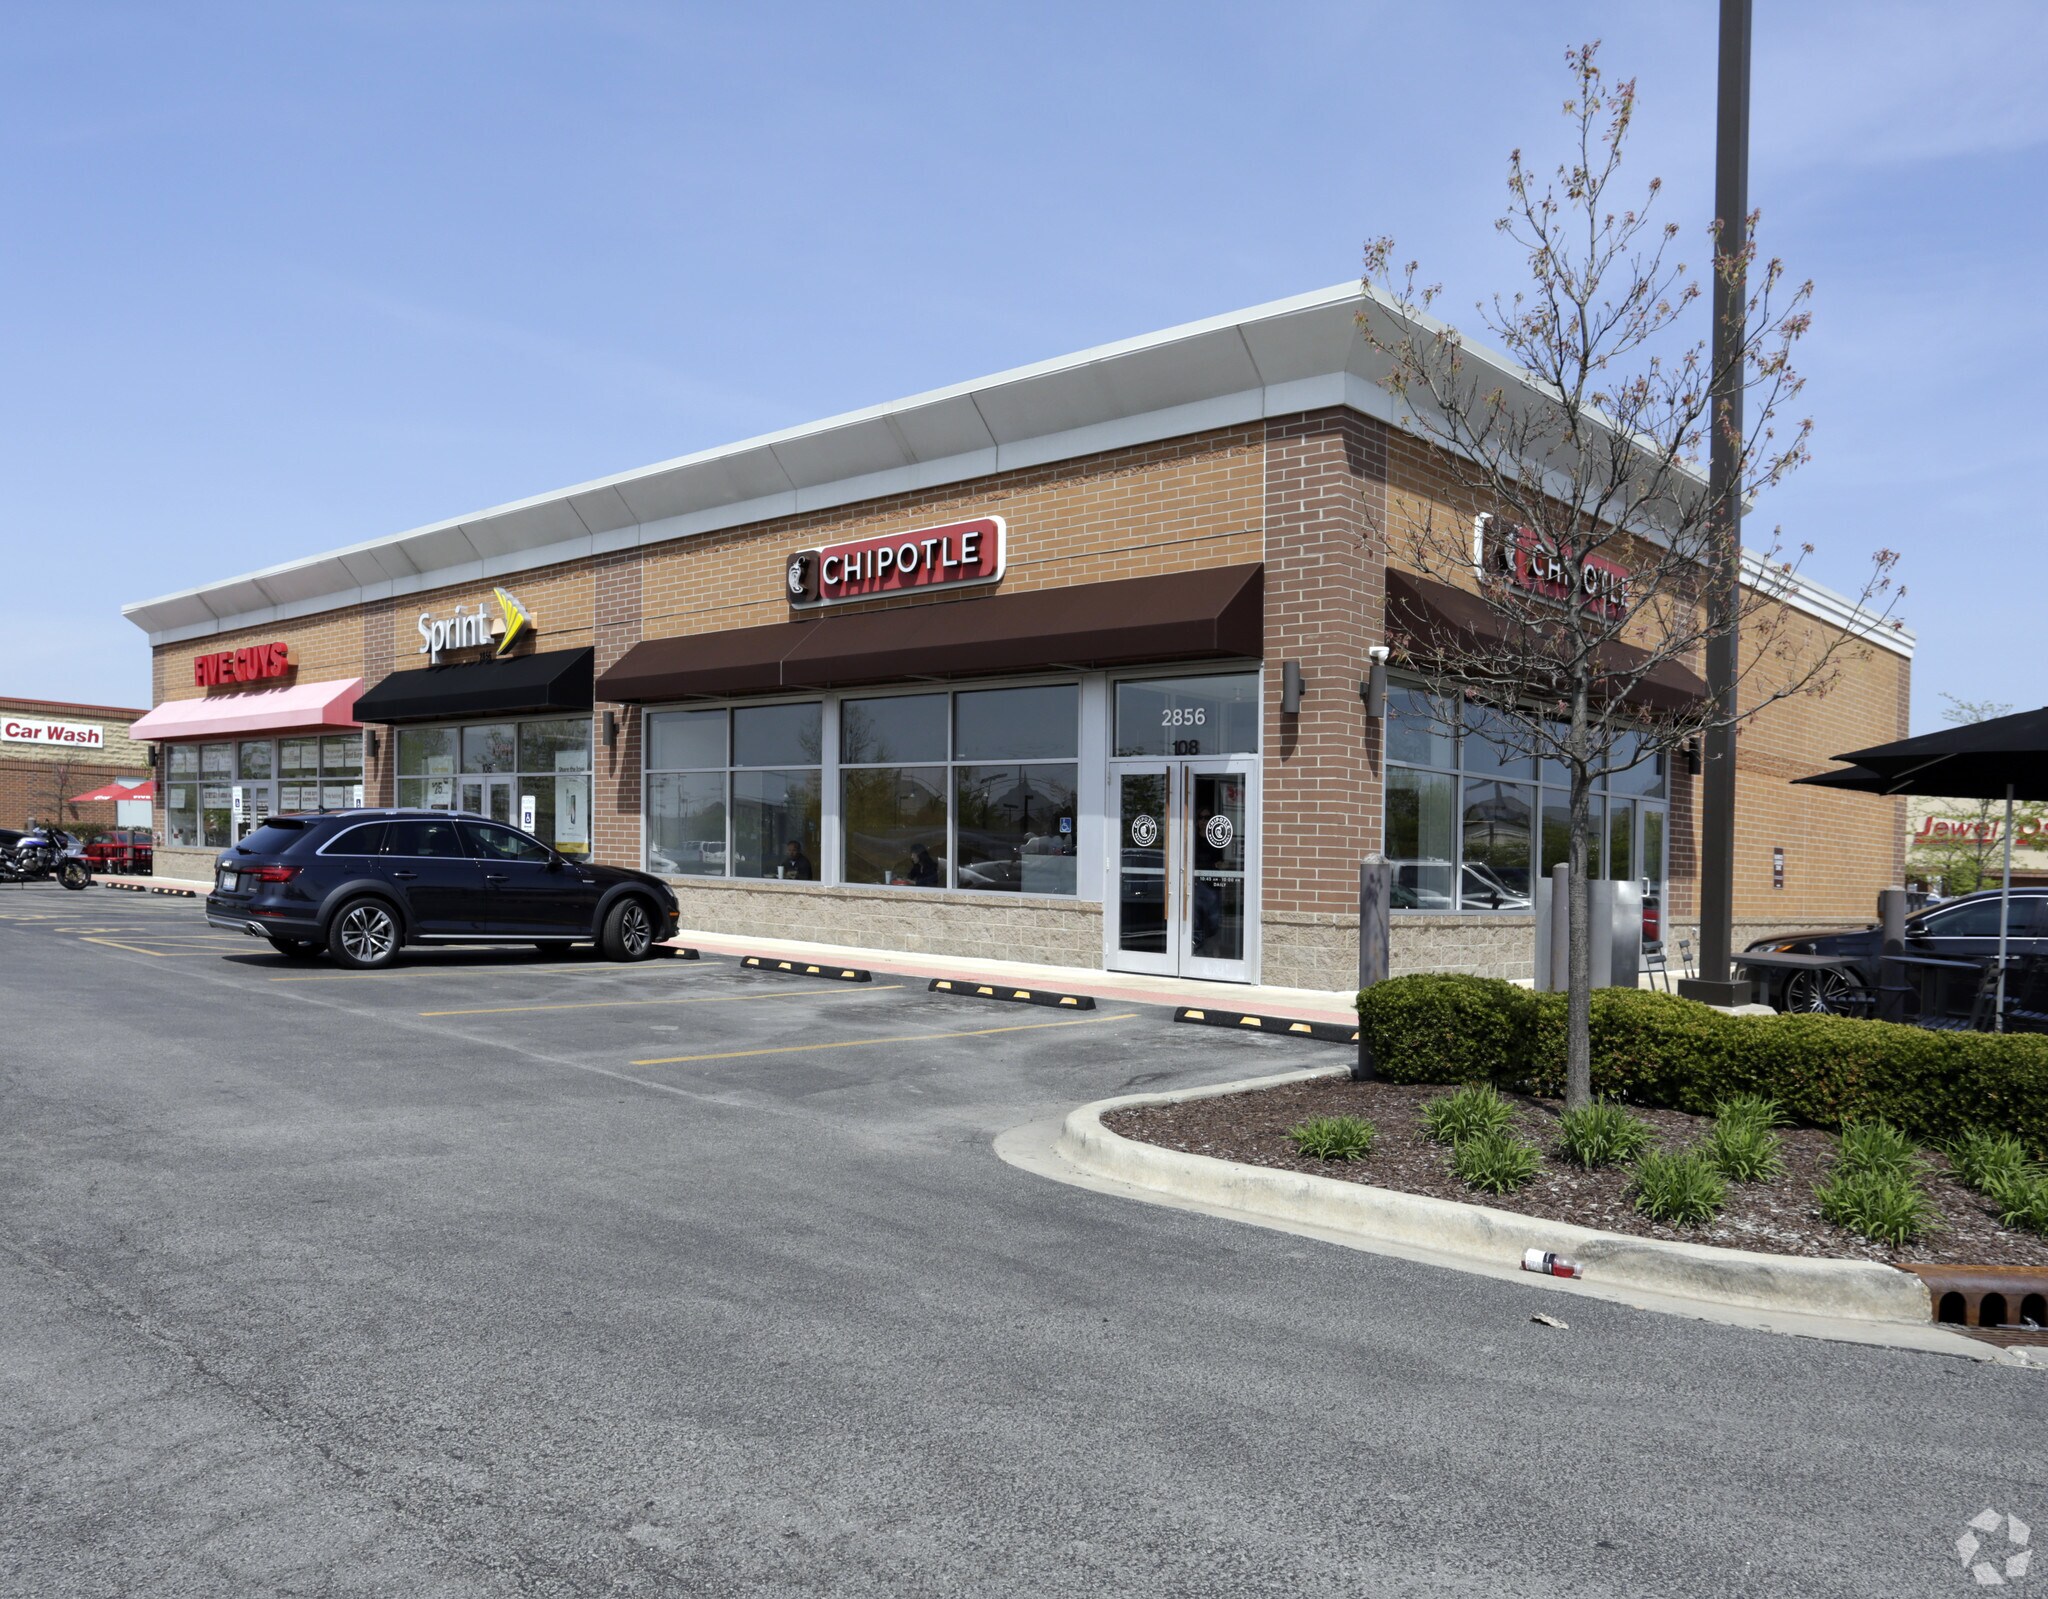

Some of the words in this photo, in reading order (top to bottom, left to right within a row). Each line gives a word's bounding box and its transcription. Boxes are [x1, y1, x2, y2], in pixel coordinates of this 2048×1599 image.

[822, 531, 980, 585] CHIPOTLE
[1532, 544, 1630, 608] CHIOTLE
[418, 603, 492, 664] Sprint
[194, 652, 234, 687] FIVE
[233, 642, 288, 682] GUYS
[5, 722, 42, 739] Car
[47, 725, 100, 743] Wash
[1161, 707, 1206, 727] 2856
[1172, 739, 1199, 756] 108
[1914, 816, 2000, 838] Jewel
